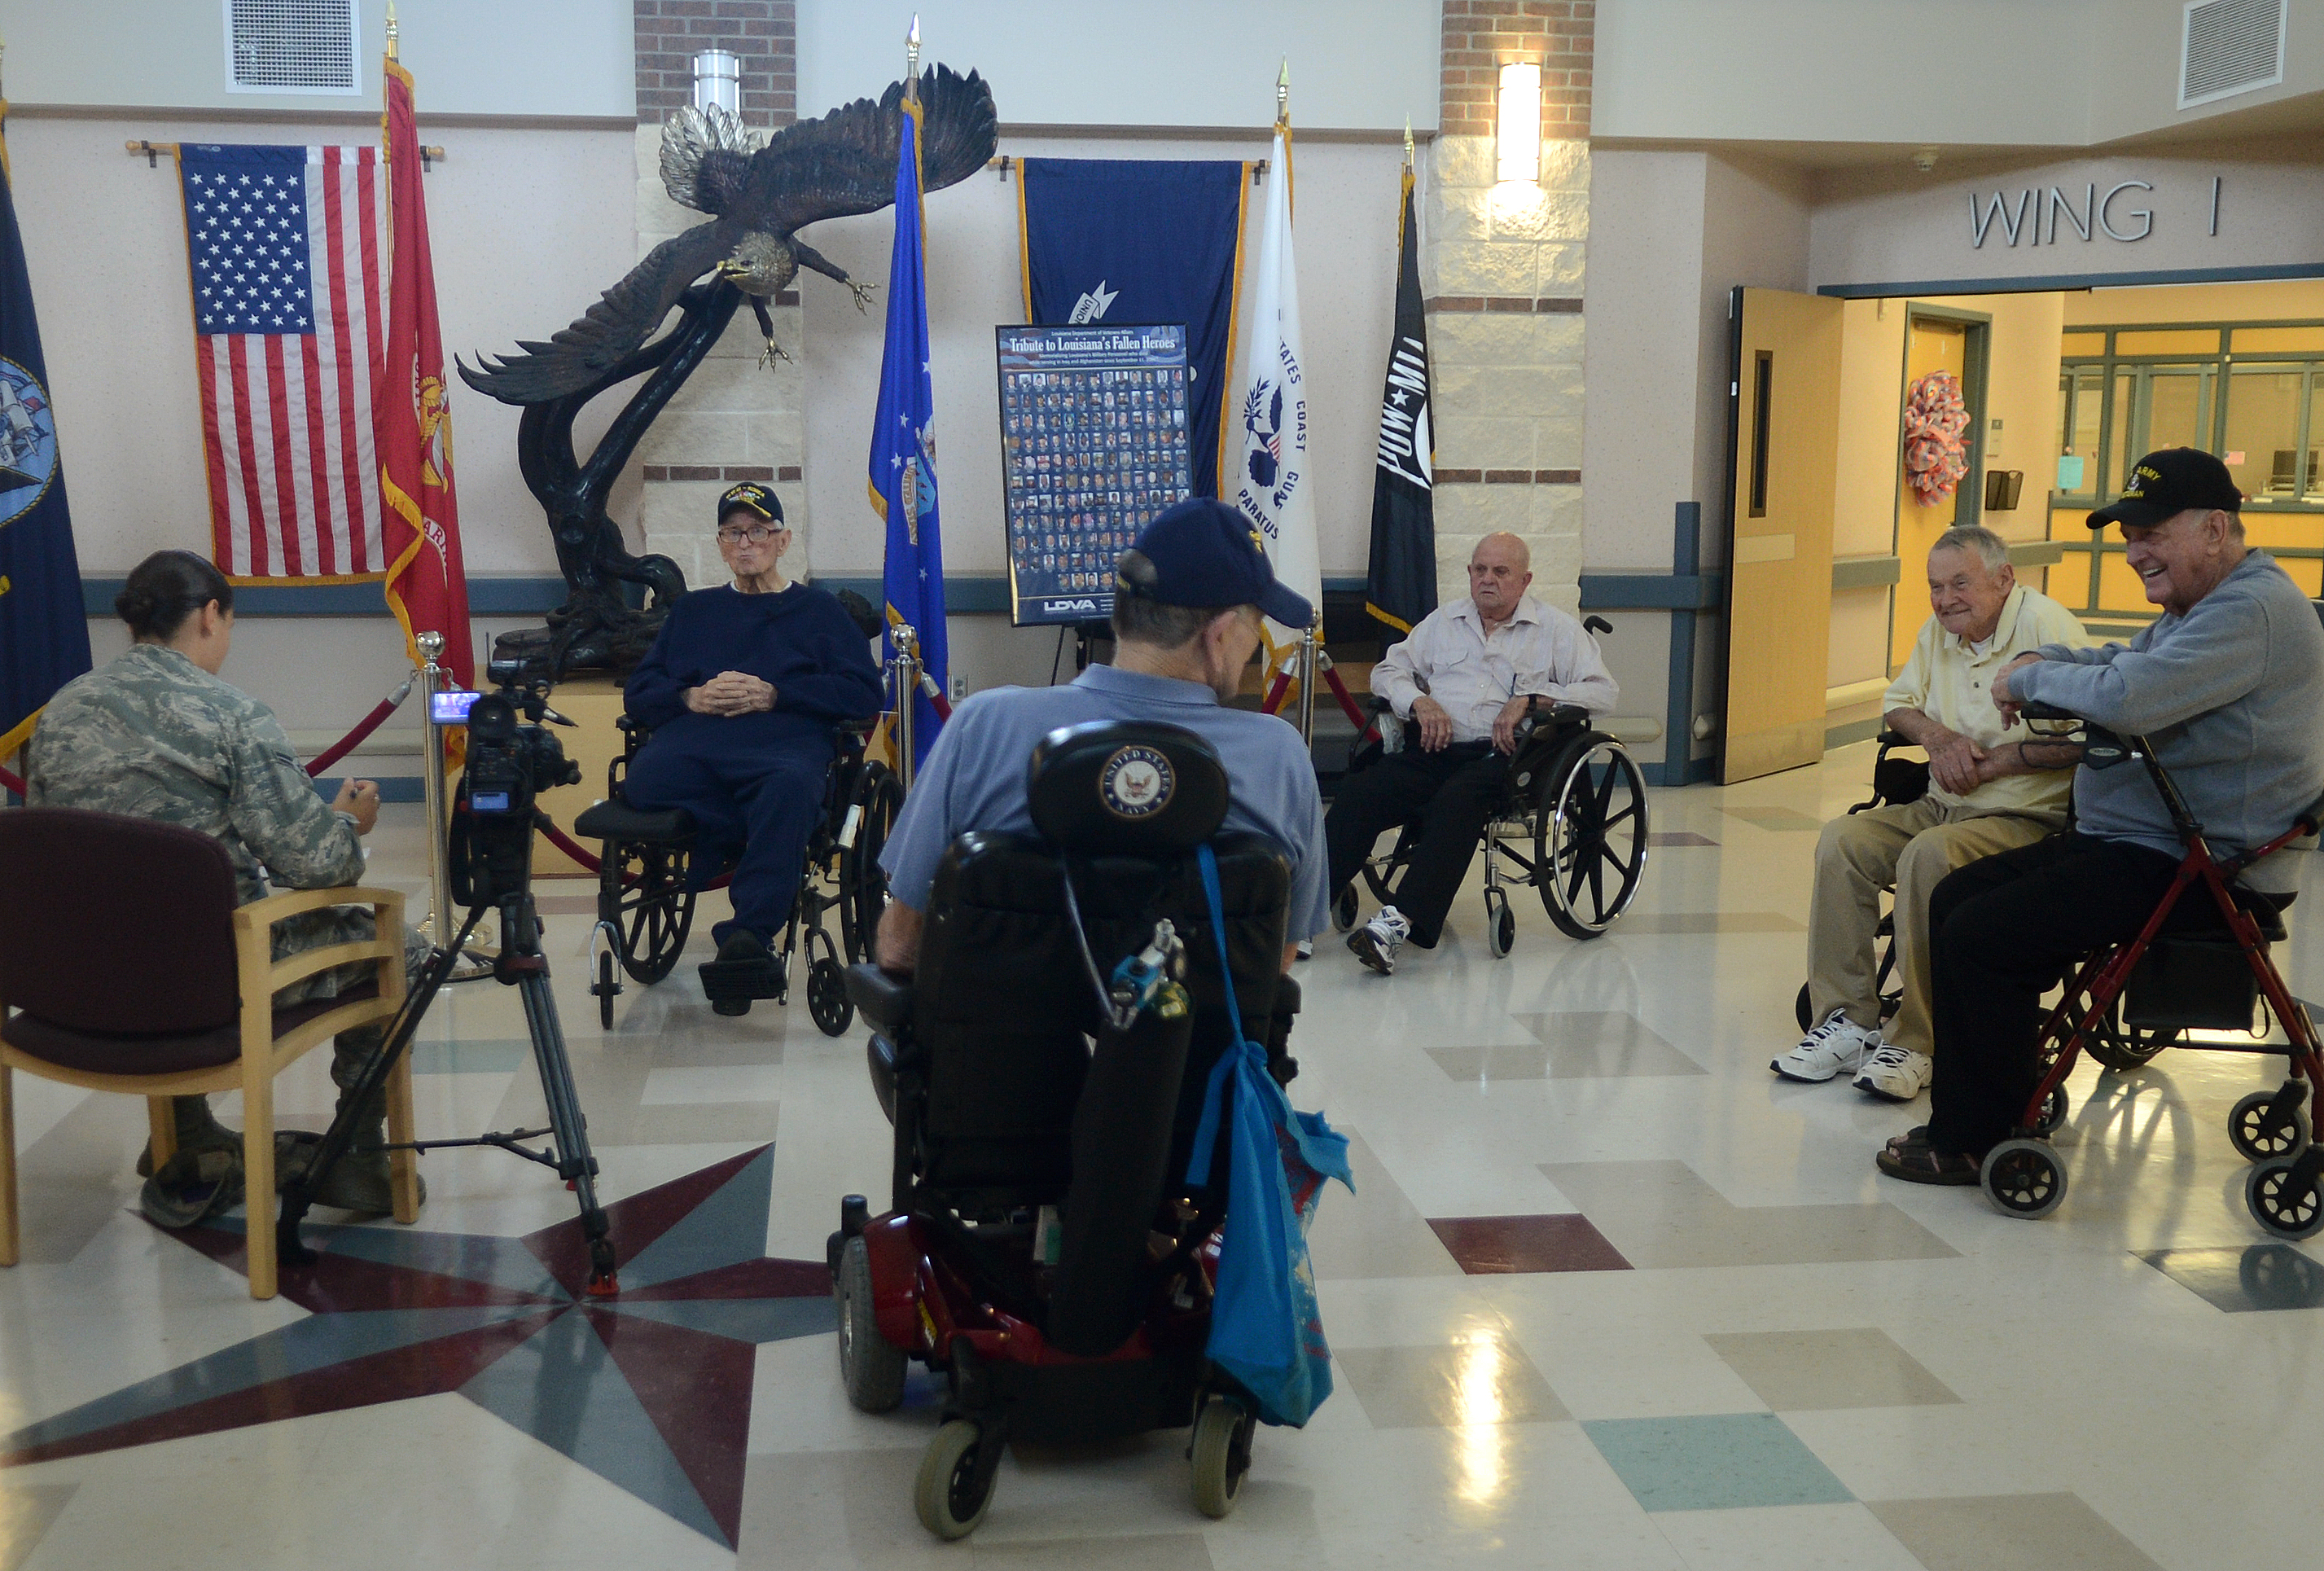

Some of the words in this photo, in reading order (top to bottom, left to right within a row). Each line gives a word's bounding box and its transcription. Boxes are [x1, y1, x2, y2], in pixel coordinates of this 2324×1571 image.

[1969, 182, 2154, 249] WING
[1009, 337, 1044, 352] Tribute
[1046, 339, 1056, 351] to
[1058, 336, 1112, 351] Louisiana's
[1112, 335, 1141, 350] Fallen
[1142, 335, 1176, 349] Heroes
[1279, 335, 1301, 384] TATES
[1296, 401, 1307, 452] COAST
[2136, 466, 2162, 481] ARMY
[1238, 488, 1279, 540] PARATUS
[1043, 599, 1098, 612] LDVA
